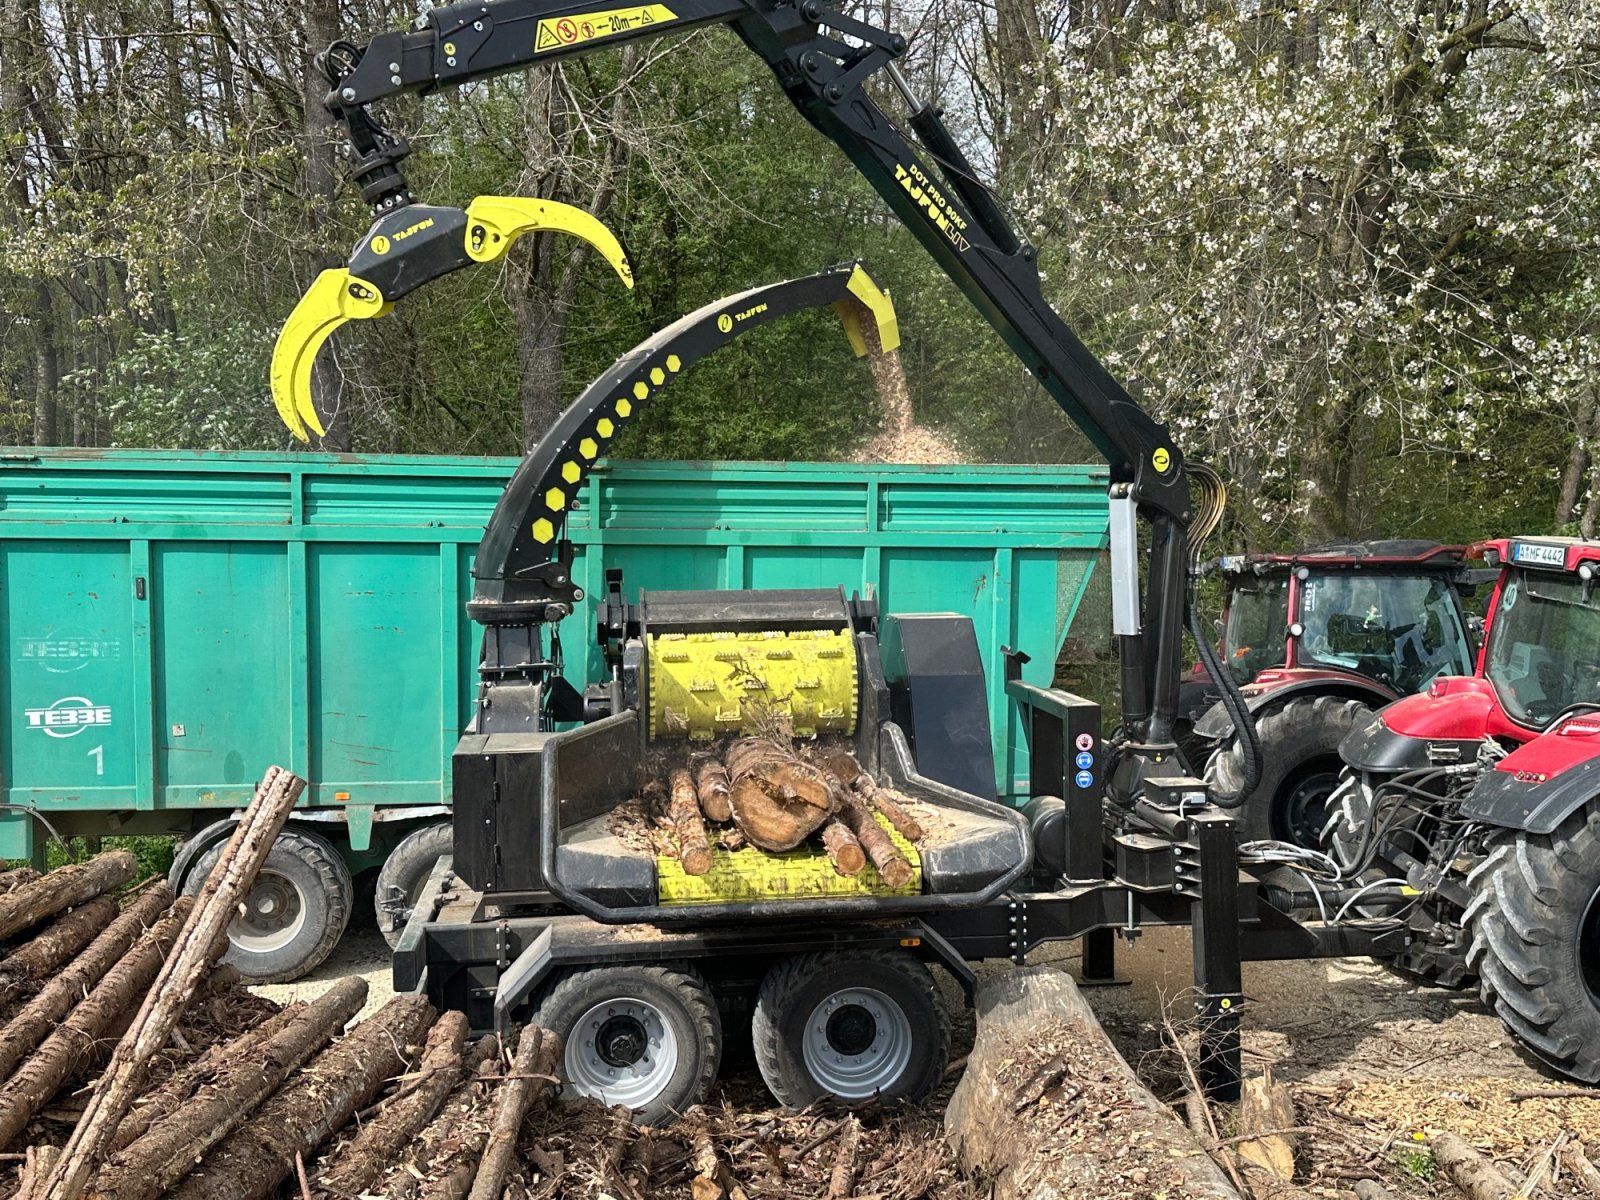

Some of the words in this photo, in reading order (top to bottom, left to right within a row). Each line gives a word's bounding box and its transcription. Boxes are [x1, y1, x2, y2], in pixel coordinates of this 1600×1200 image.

[609, 15, 630, 32] 20m
[909, 163, 929, 187] DOT
[927, 184, 946, 207] PRO
[392, 217, 435, 241] TAJFUN
[735, 302, 768, 321] TAJFUN
[25, 708, 111, 726] TEBBE
[88, 744, 104, 775] 1
